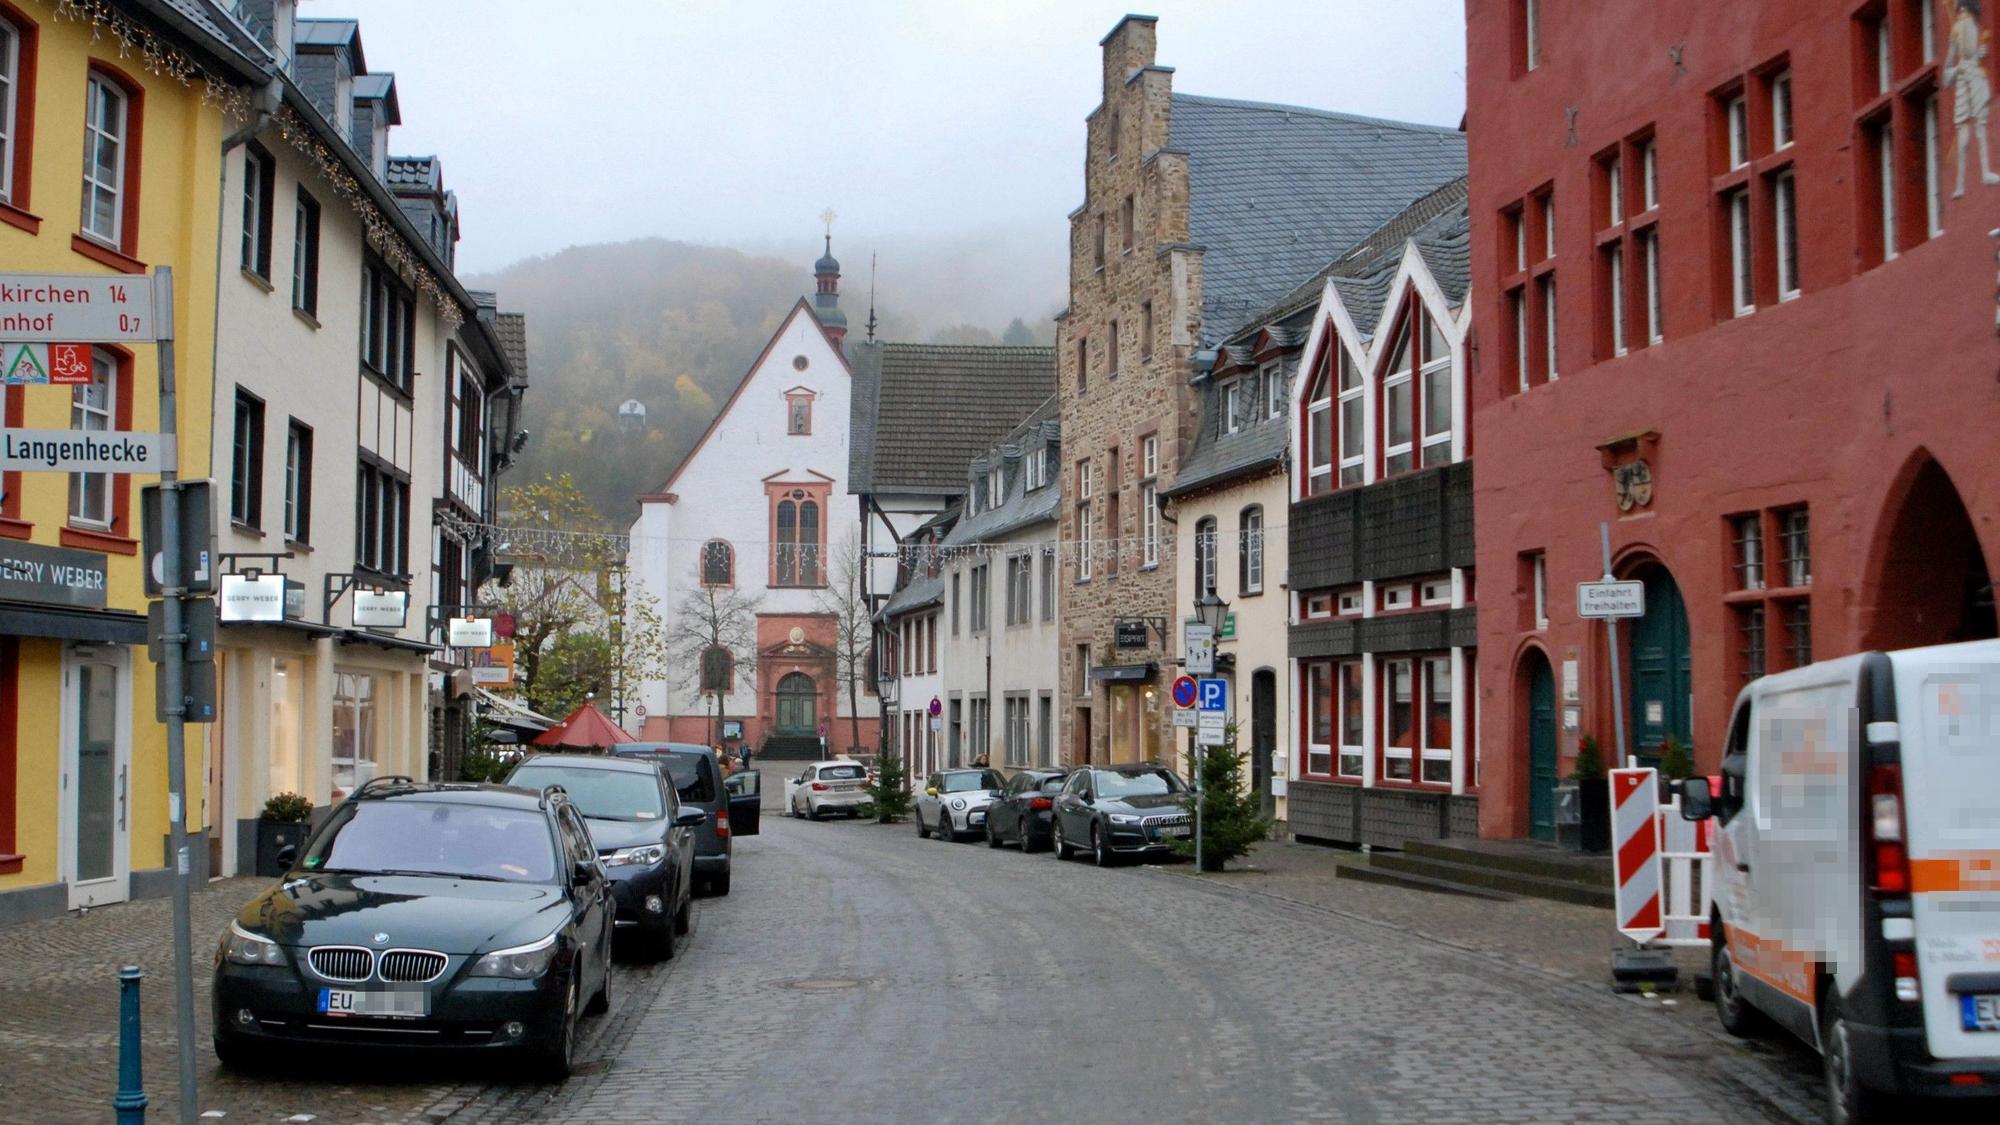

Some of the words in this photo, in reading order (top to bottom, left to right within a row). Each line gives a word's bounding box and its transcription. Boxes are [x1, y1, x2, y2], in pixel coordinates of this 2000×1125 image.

[1, 283, 90, 304] kirchen
[109, 285, 127, 303] 14
[0, 312, 54, 332] nhof
[6, 434, 148, 467] Langenhecke
[0, 558, 44, 583] ERRY
[50, 563, 103, 591] WEBER
[1588, 588, 1632, 598] Einfahrt
[1584, 601, 1637, 611] freihalten
[1204, 684, 1220, 708] P
[329, 992, 353, 1010] EU
